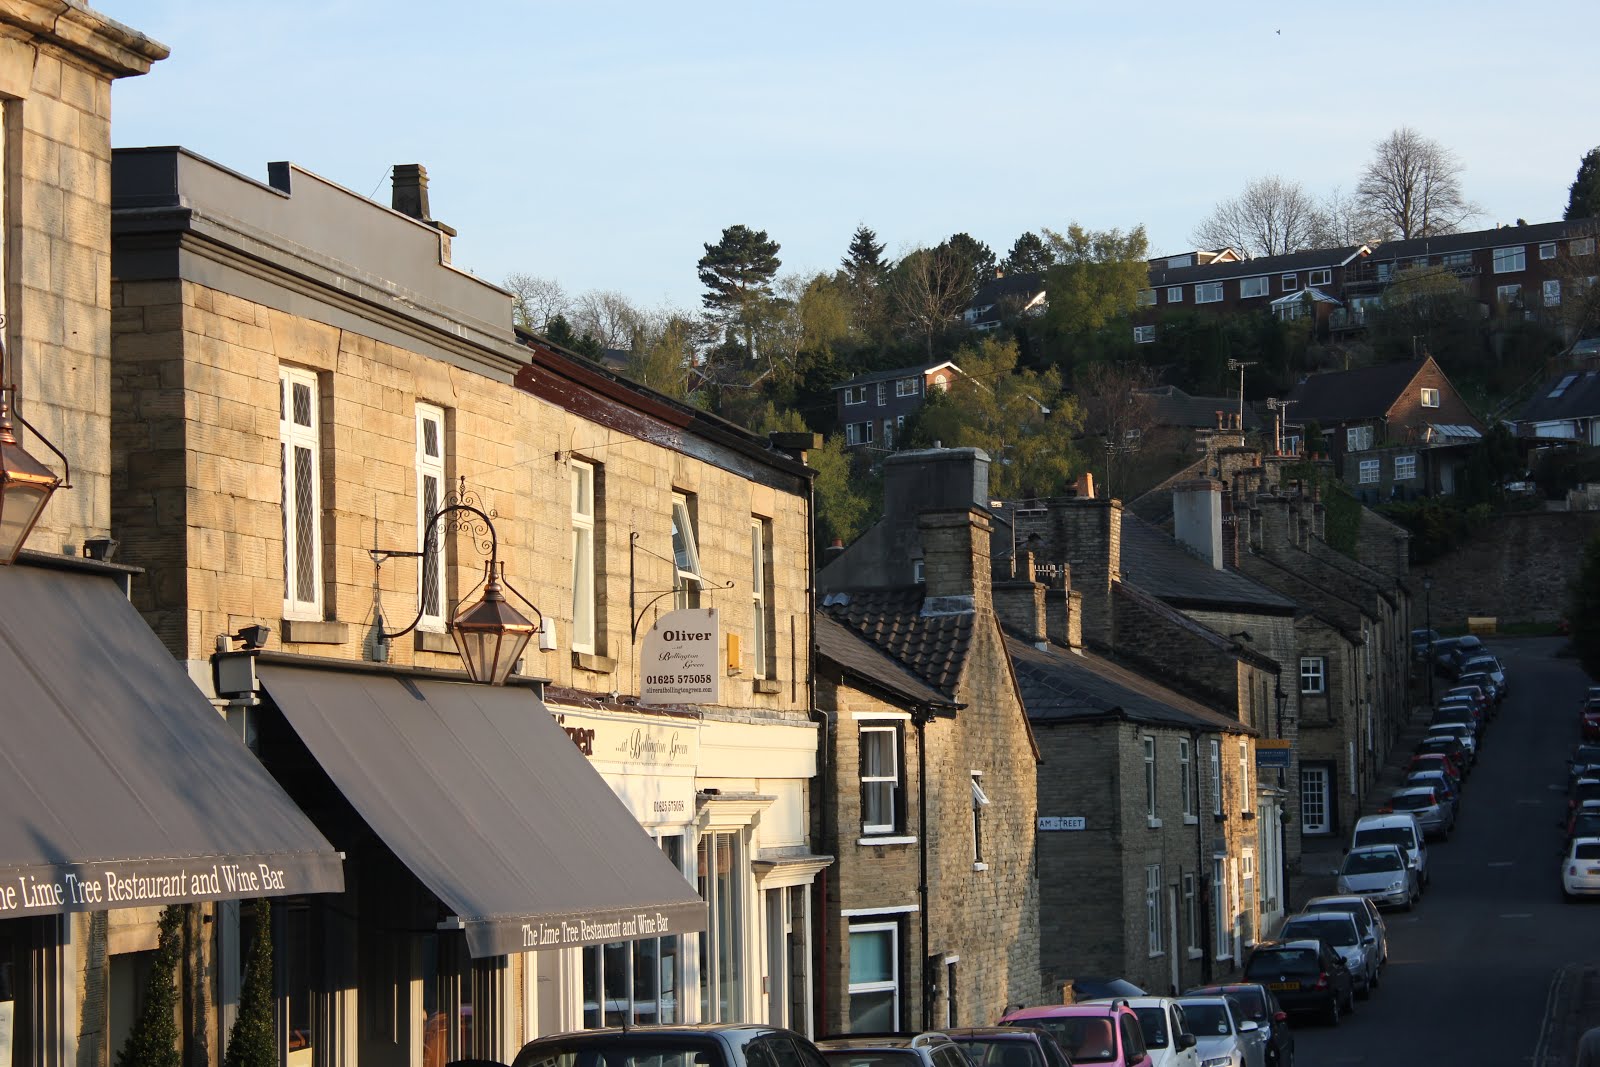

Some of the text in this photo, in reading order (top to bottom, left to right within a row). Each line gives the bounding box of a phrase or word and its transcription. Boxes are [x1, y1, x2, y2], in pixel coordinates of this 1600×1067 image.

[663, 630, 712, 642] Oliver
[658, 651, 699, 661] Bollington
[682, 660, 705, 669] Green
[646, 674, 712, 684] 01625 575058
[629, 727, 667, 760] Bollington
[669, 730, 689, 761] Green
[1054, 819, 1083, 827] STREET
[18, 876, 65, 908] Lime
[65, 873, 102, 904] Tree
[105, 871, 187, 902] Restaurant
[191, 865, 222, 895] and
[221, 864, 260, 893] Wine
[258, 863, 286, 890] Bar
[522, 913, 669, 947] The Lime Tree Restaurant and Wine Bar
